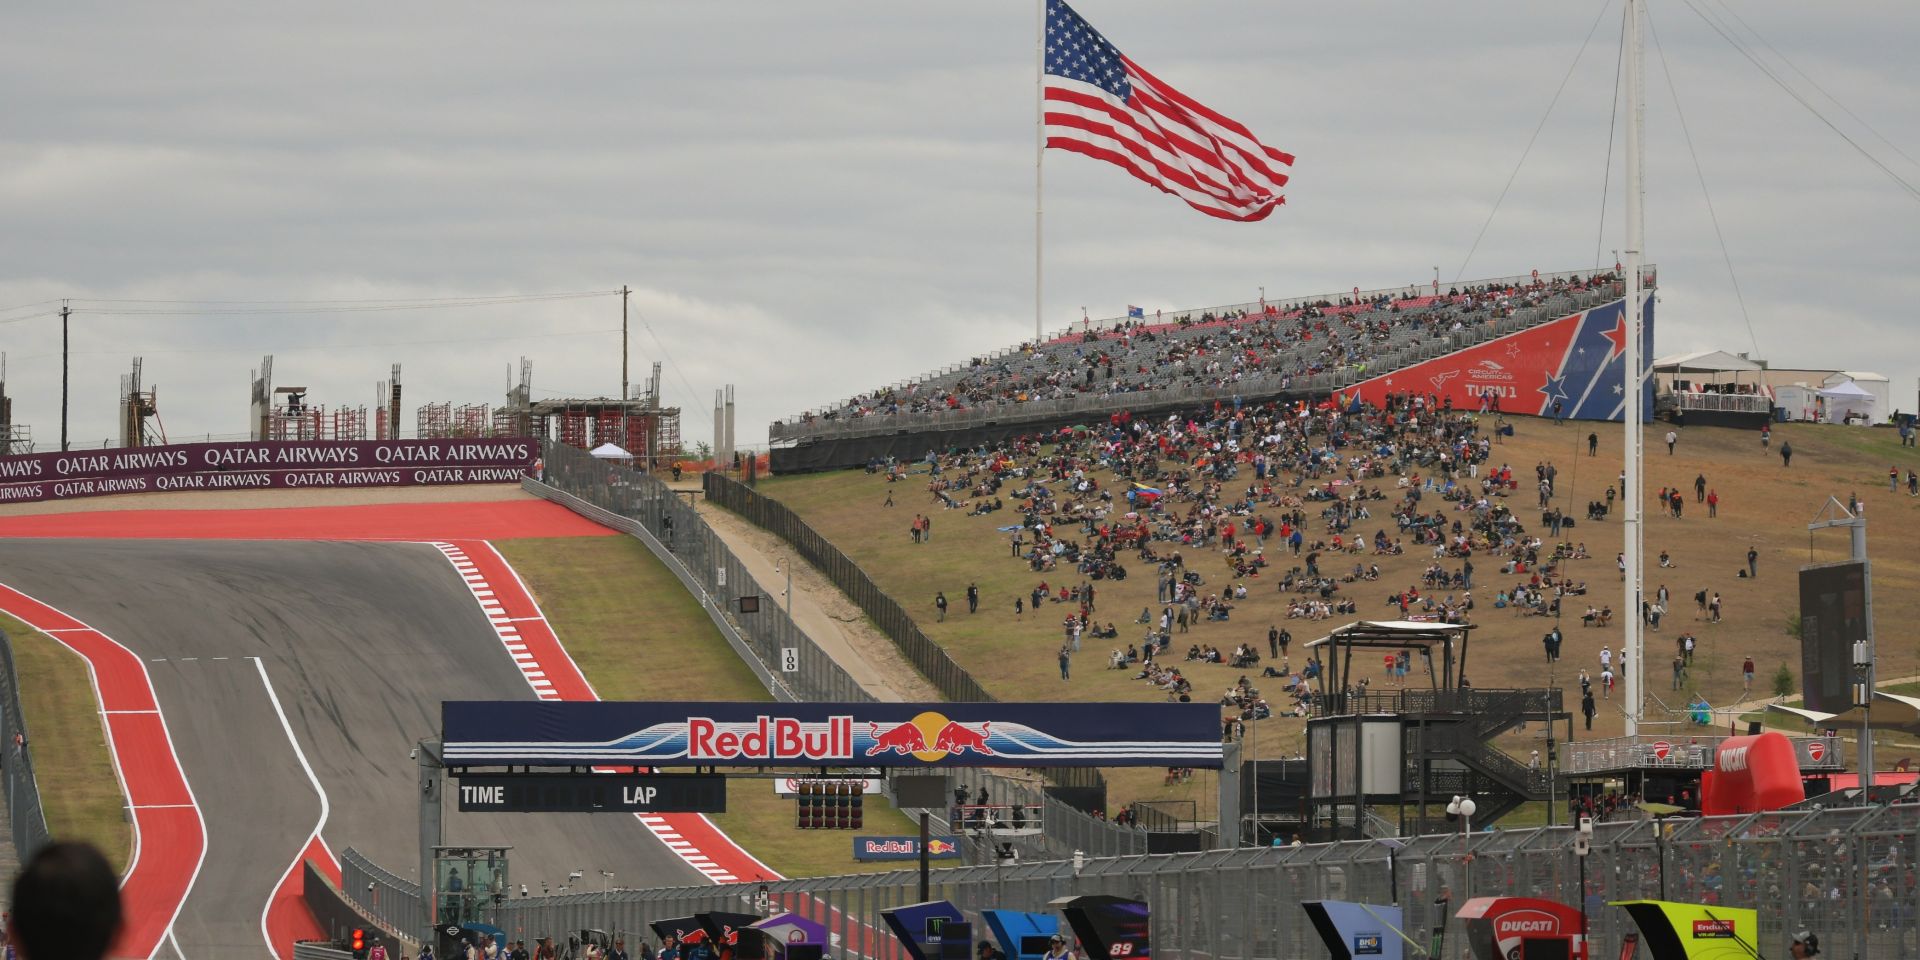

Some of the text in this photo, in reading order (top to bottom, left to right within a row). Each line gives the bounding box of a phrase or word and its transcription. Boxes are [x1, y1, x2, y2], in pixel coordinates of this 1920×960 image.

[1465, 384, 1518, 398] TURN 1
[0, 444, 529, 477] WAYS QATAR AIRWAYS QATAR AIRWAYS QATAR AIRWAYS
[0, 468, 527, 500] IRWAYS QATAR AIRWAYS QATAR AIRWAYS QATAR AIRWAYS QATAR AIRWAYS
[786, 649, 795, 671] 100
[687, 715, 853, 760] Red Bull
[1720, 746, 1748, 772] DUCATI
[461, 786, 657, 804] TIME LAP
[866, 840, 913, 854] Red Bull
[1500, 920, 1553, 932] DUCATI
[1110, 943, 1133, 956] 89
